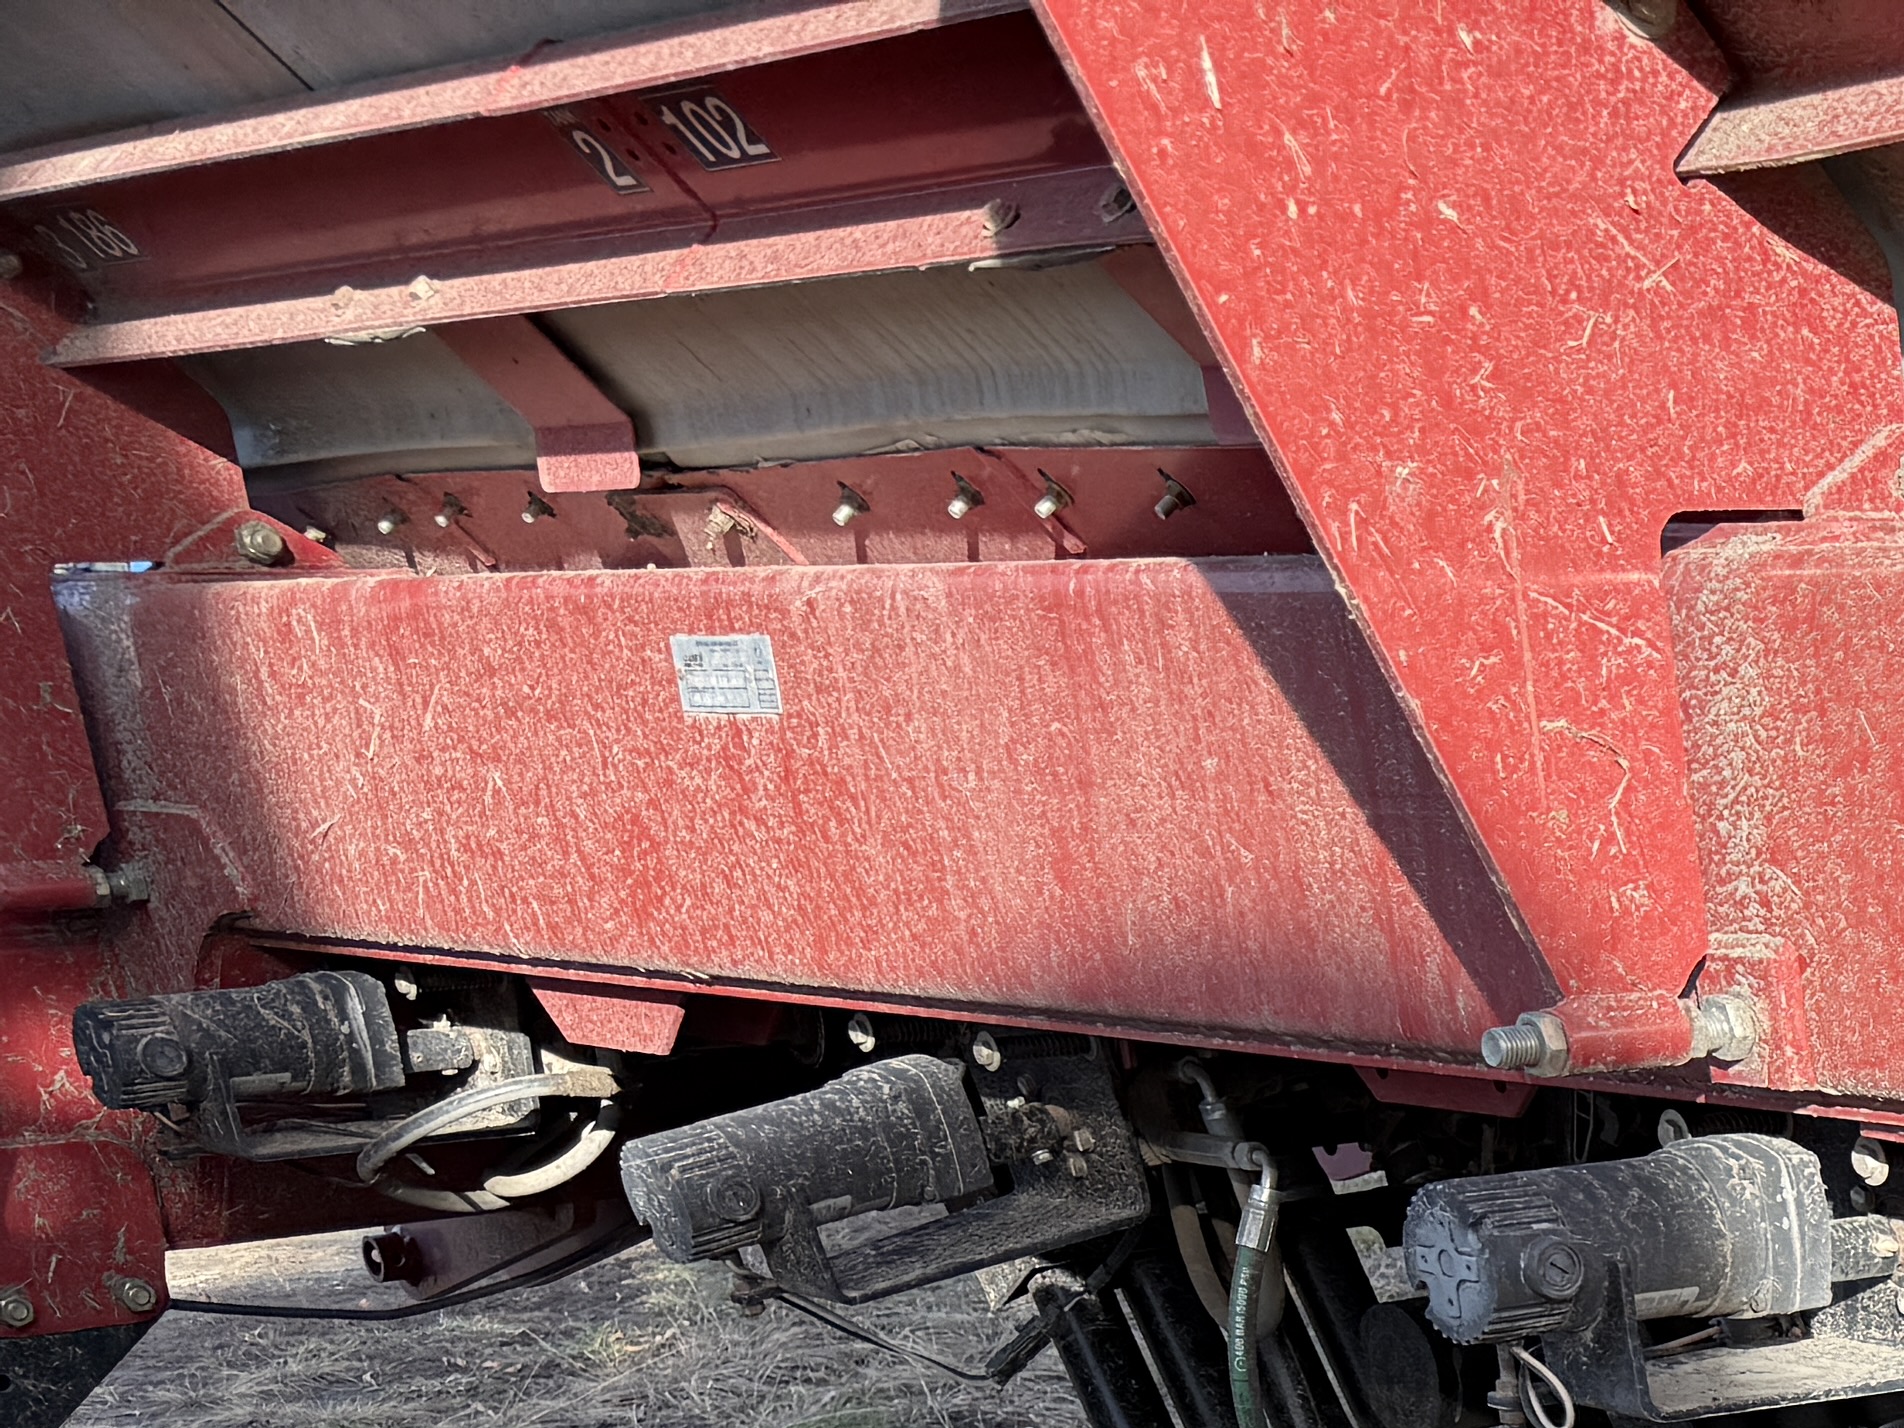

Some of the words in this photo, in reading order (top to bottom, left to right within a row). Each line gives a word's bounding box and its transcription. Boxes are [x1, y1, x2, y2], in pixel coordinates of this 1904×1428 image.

[661, 96, 771, 162] 102
[572, 130, 637, 186] 2
[56, 208, 140, 258] 186
[1235, 1315, 1246, 1337] BAR
